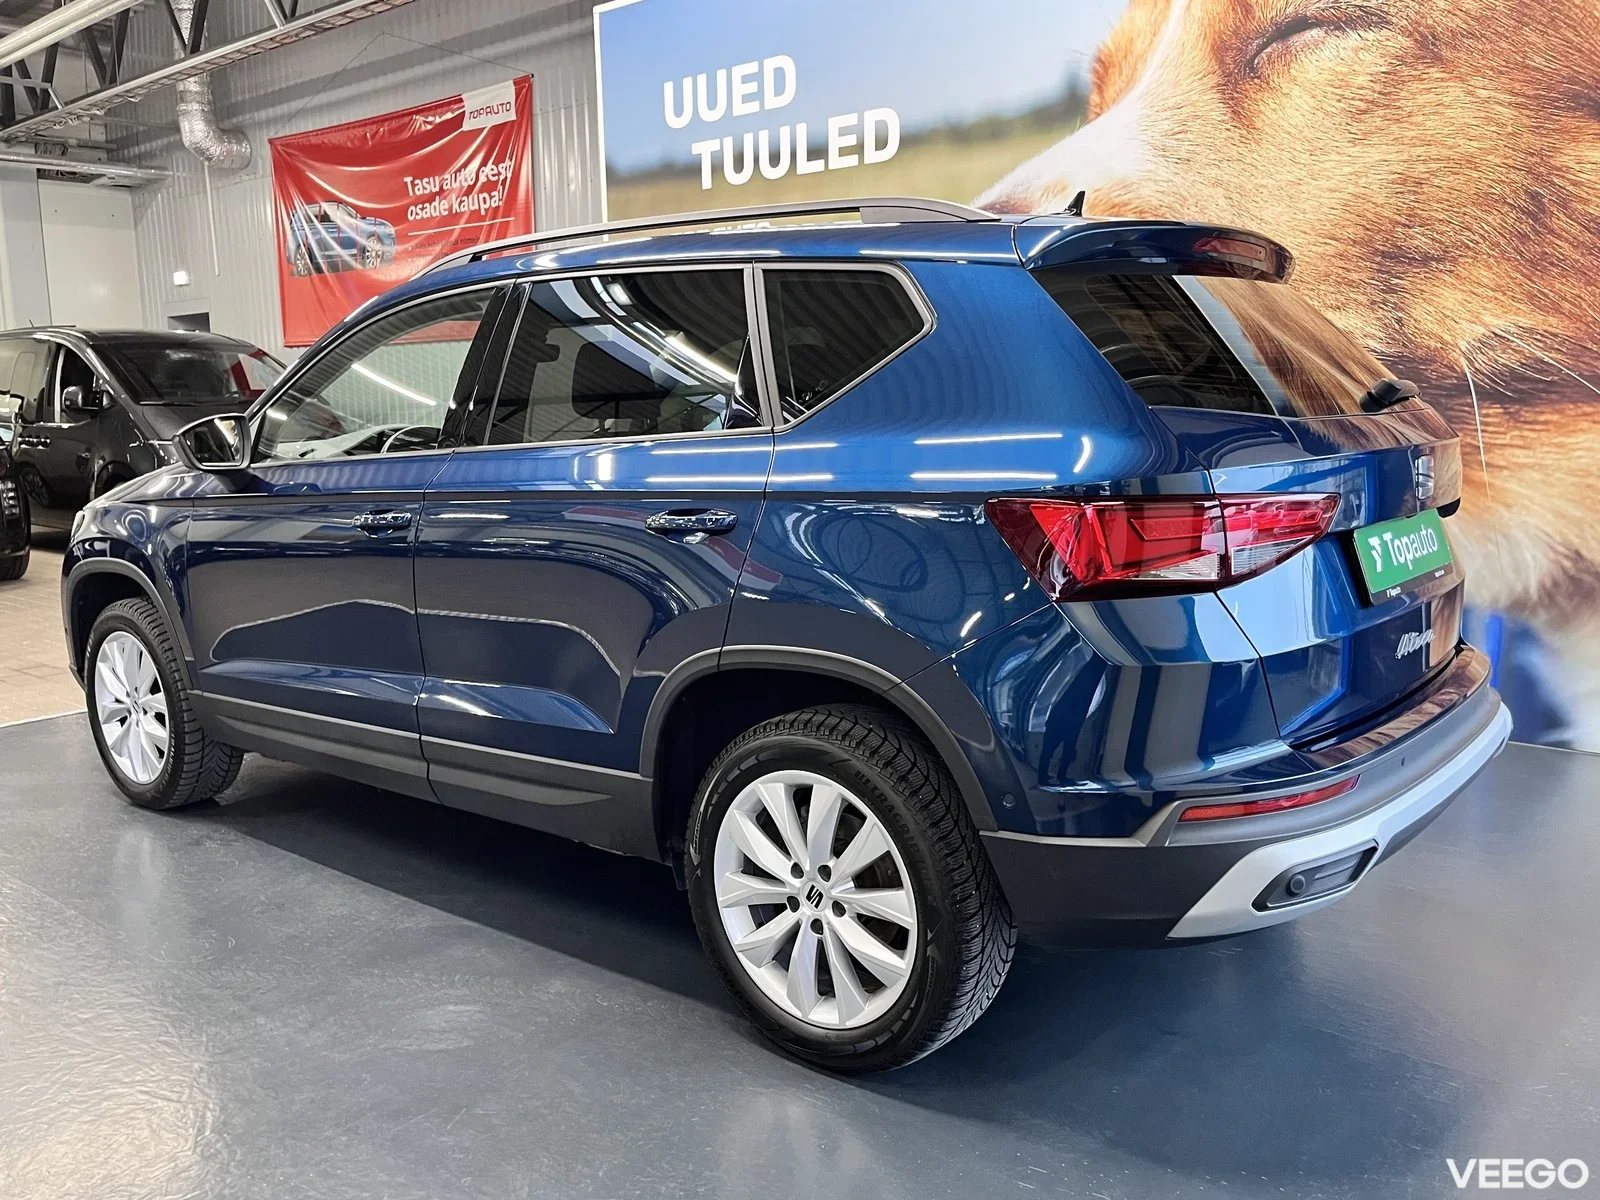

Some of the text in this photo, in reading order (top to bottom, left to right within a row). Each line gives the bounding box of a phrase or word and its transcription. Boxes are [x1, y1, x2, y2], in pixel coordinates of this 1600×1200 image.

[468, 101, 512, 120] TOPAUTO
[663, 54, 797, 129] UUED
[691, 107, 900, 190] TUULED
[403, 160, 512, 197] Tasu auto eest
[407, 185, 503, 221] osade kaupa!
[1382, 524, 1438, 571] Topauto
